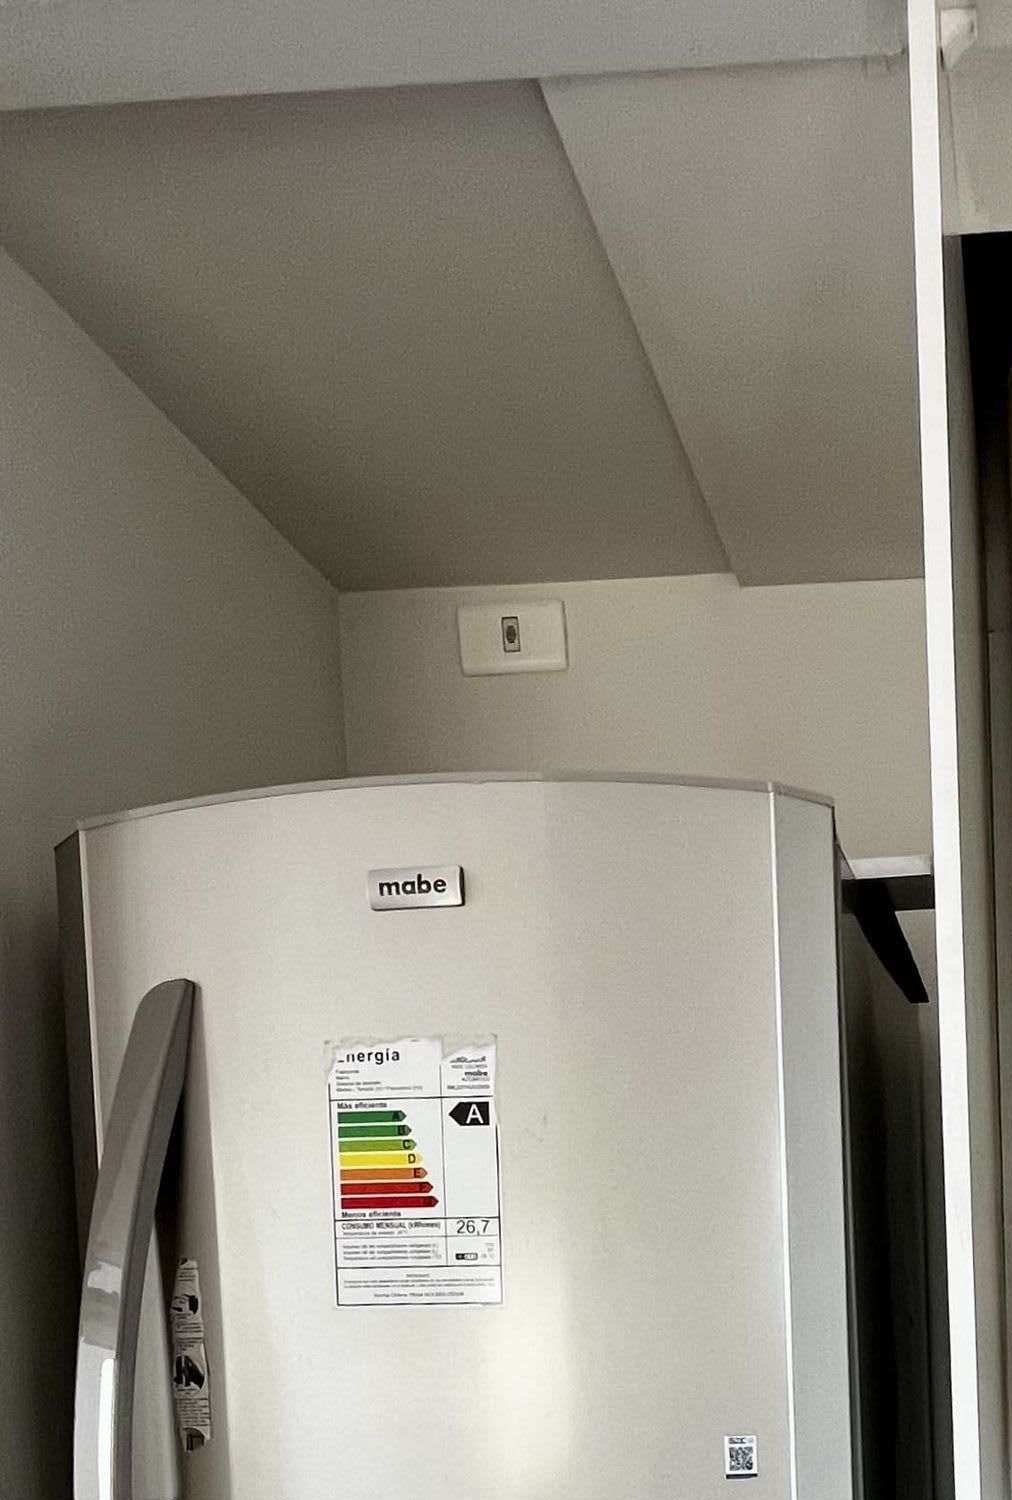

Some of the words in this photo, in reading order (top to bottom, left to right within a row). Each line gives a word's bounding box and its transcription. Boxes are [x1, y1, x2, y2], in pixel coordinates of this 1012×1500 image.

[378, 873, 447, 897] mabe
[337, 1048, 400, 1065] nergía
[466, 1103, 484, 1124] A
[402, 1139, 411, 1150] C
[407, 1153, 416, 1164] D
[414, 1168, 421, 1178] E
[341, 1222, 374, 1230] CONSUMO
[376, 1221, 406, 1230] MENSUAL
[456, 1219, 490, 1236] 26,7
